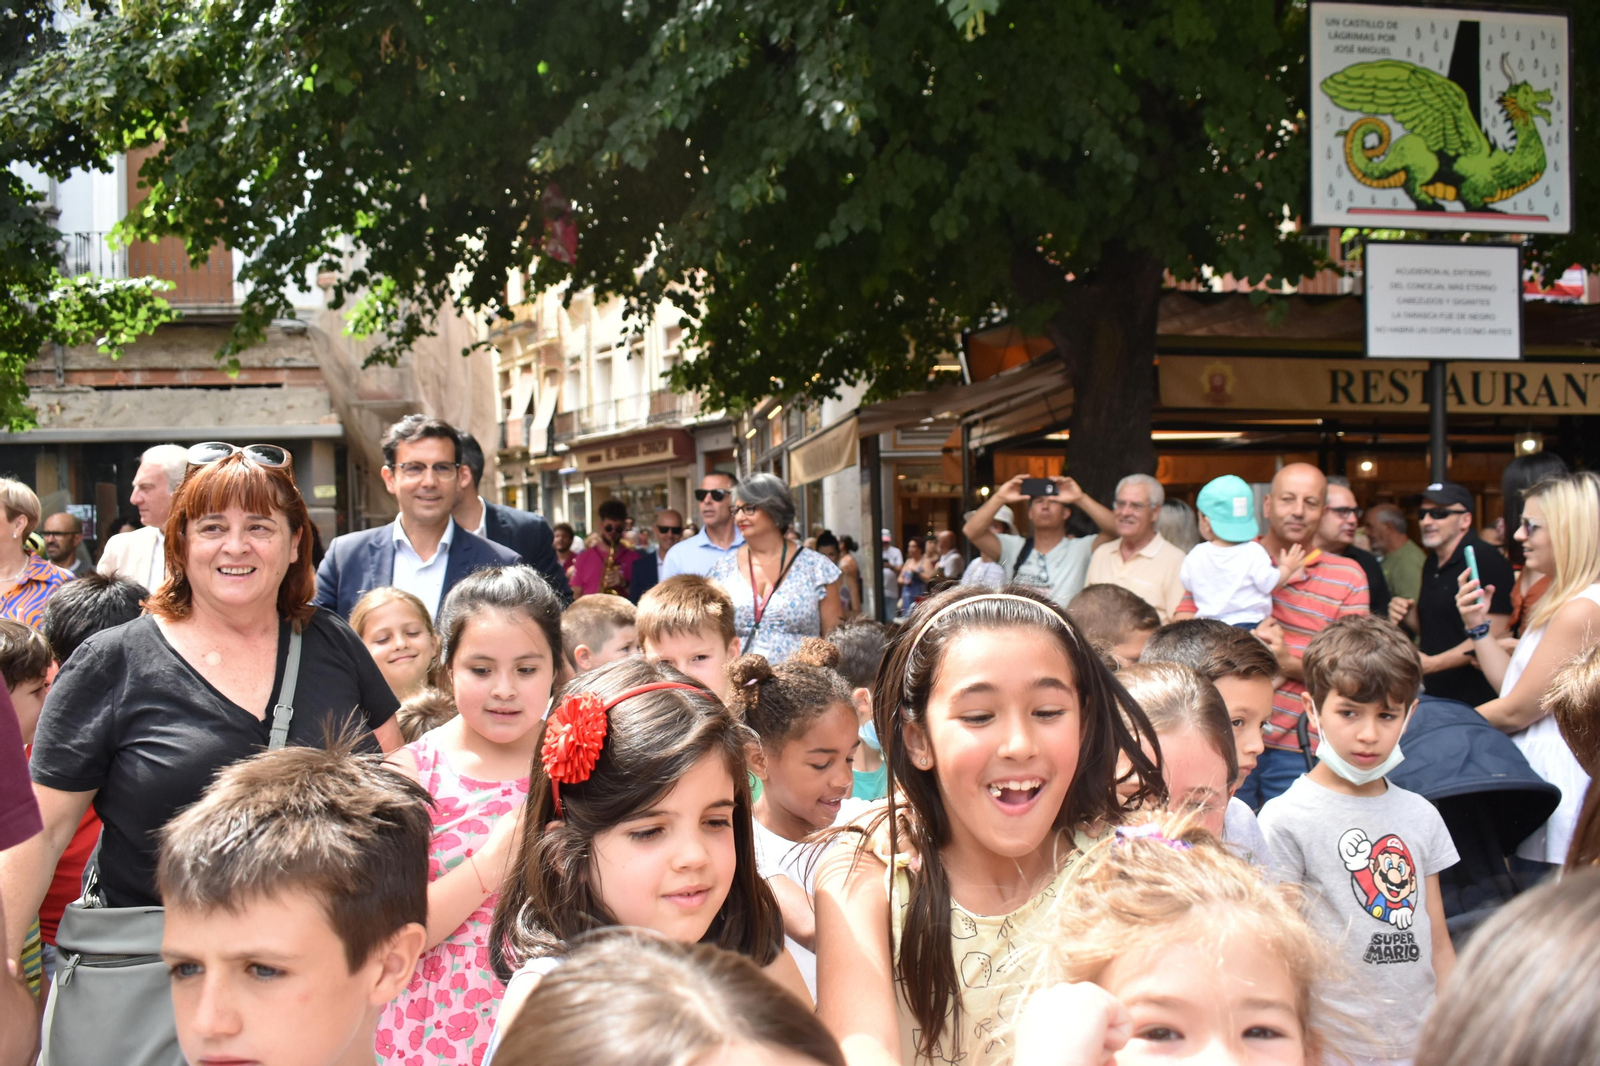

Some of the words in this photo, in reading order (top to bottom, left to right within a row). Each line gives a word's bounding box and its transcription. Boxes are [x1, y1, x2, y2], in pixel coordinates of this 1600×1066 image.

[1325, 17, 1340, 27] UN
[1342, 18, 1385, 29] CASTILLO
[1386, 20, 1398, 30] DE
[1377, 33, 1396, 42] POR
[1357, 45, 1391, 55] MIGUEL
[1328, 368, 1600, 408] RESTAURAN
[1372, 932, 1415, 945] SUPER
[1363, 943, 1420, 963] MARIO
